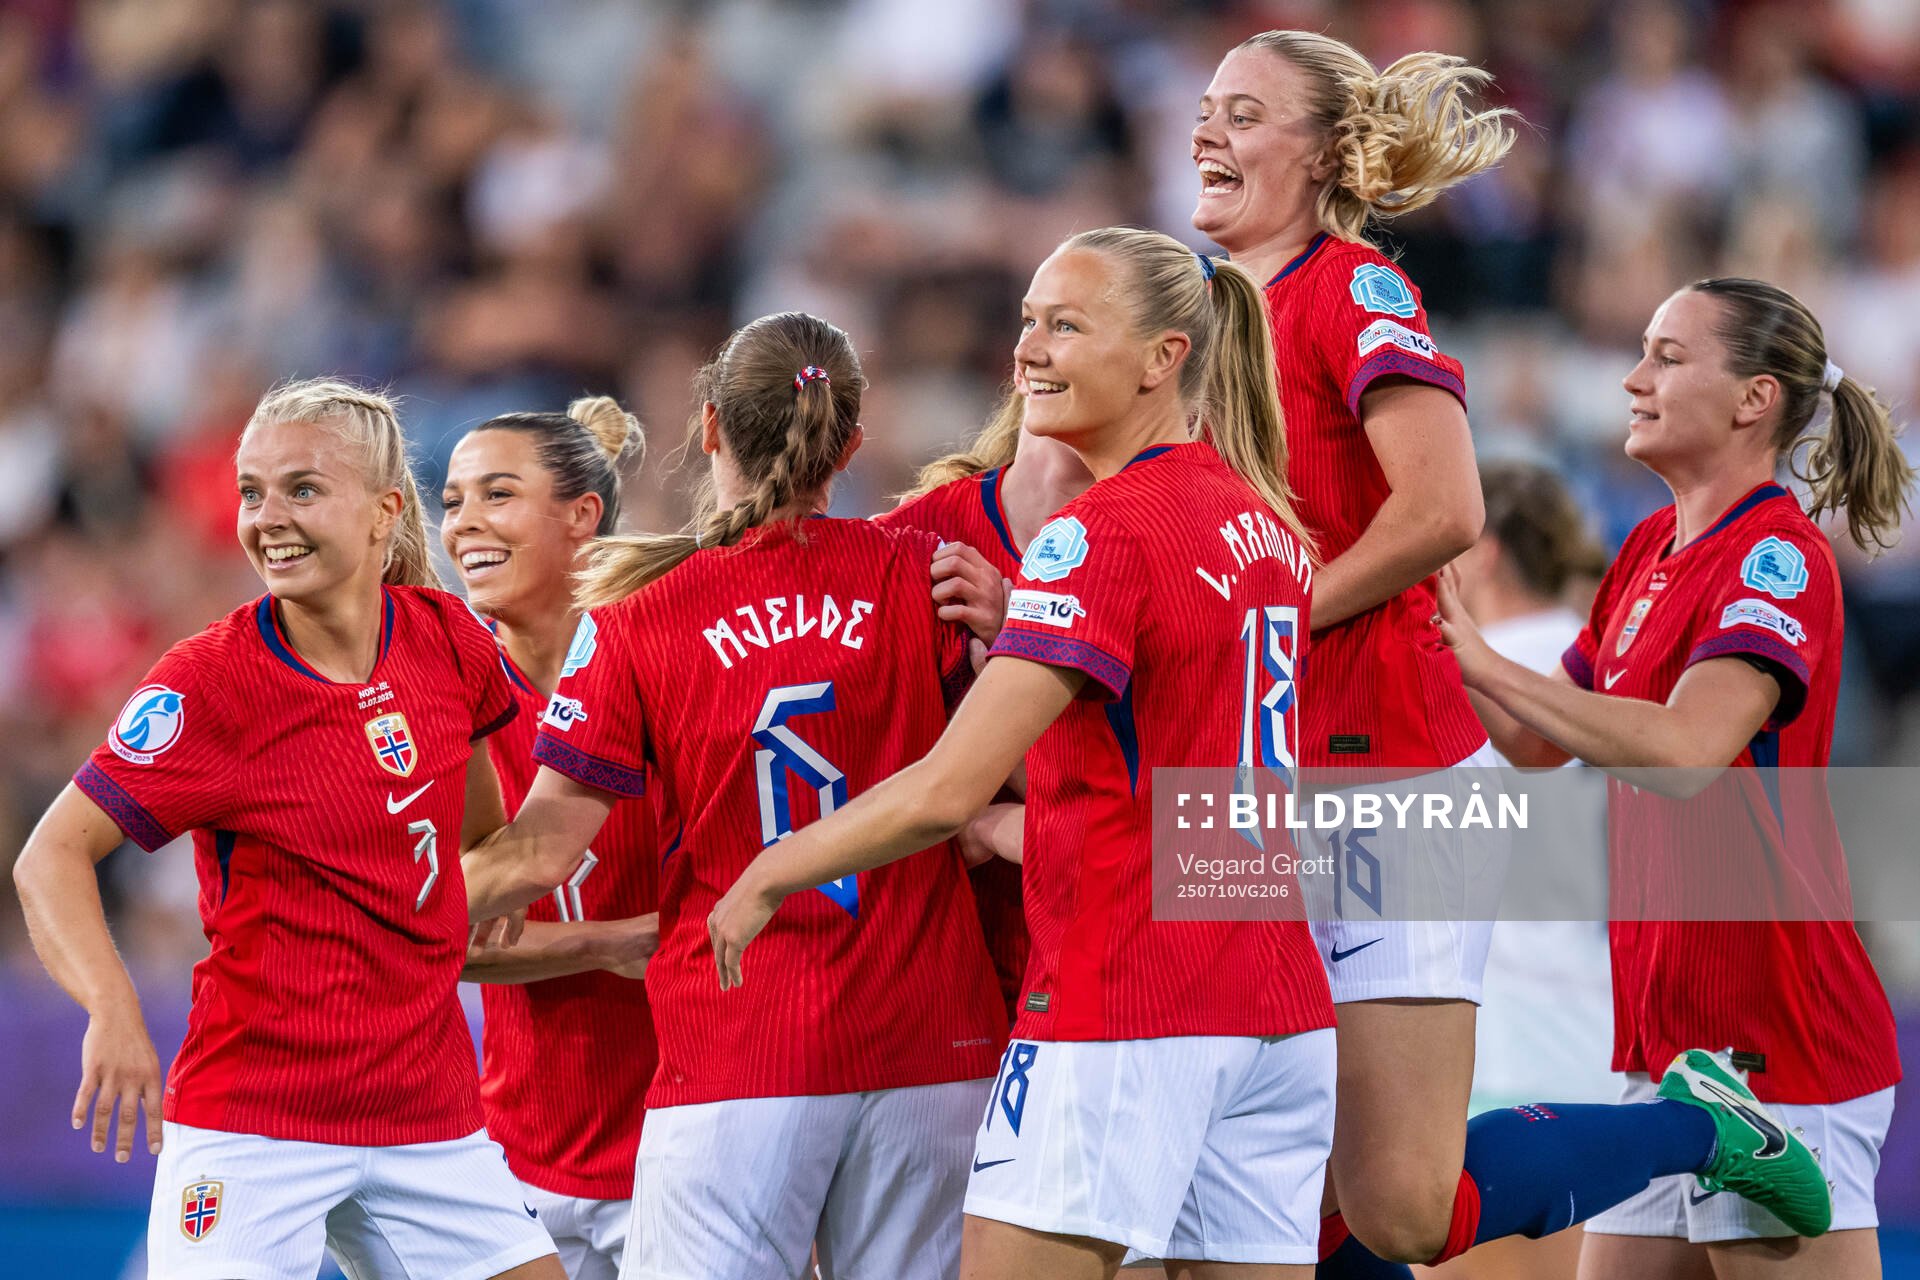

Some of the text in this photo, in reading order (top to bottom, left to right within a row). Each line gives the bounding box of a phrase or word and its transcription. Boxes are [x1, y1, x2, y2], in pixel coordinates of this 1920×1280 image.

[702, 594, 874, 669] MJELDE
[751, 680, 860, 920] 6
[986, 1042, 1040, 1138] 18
